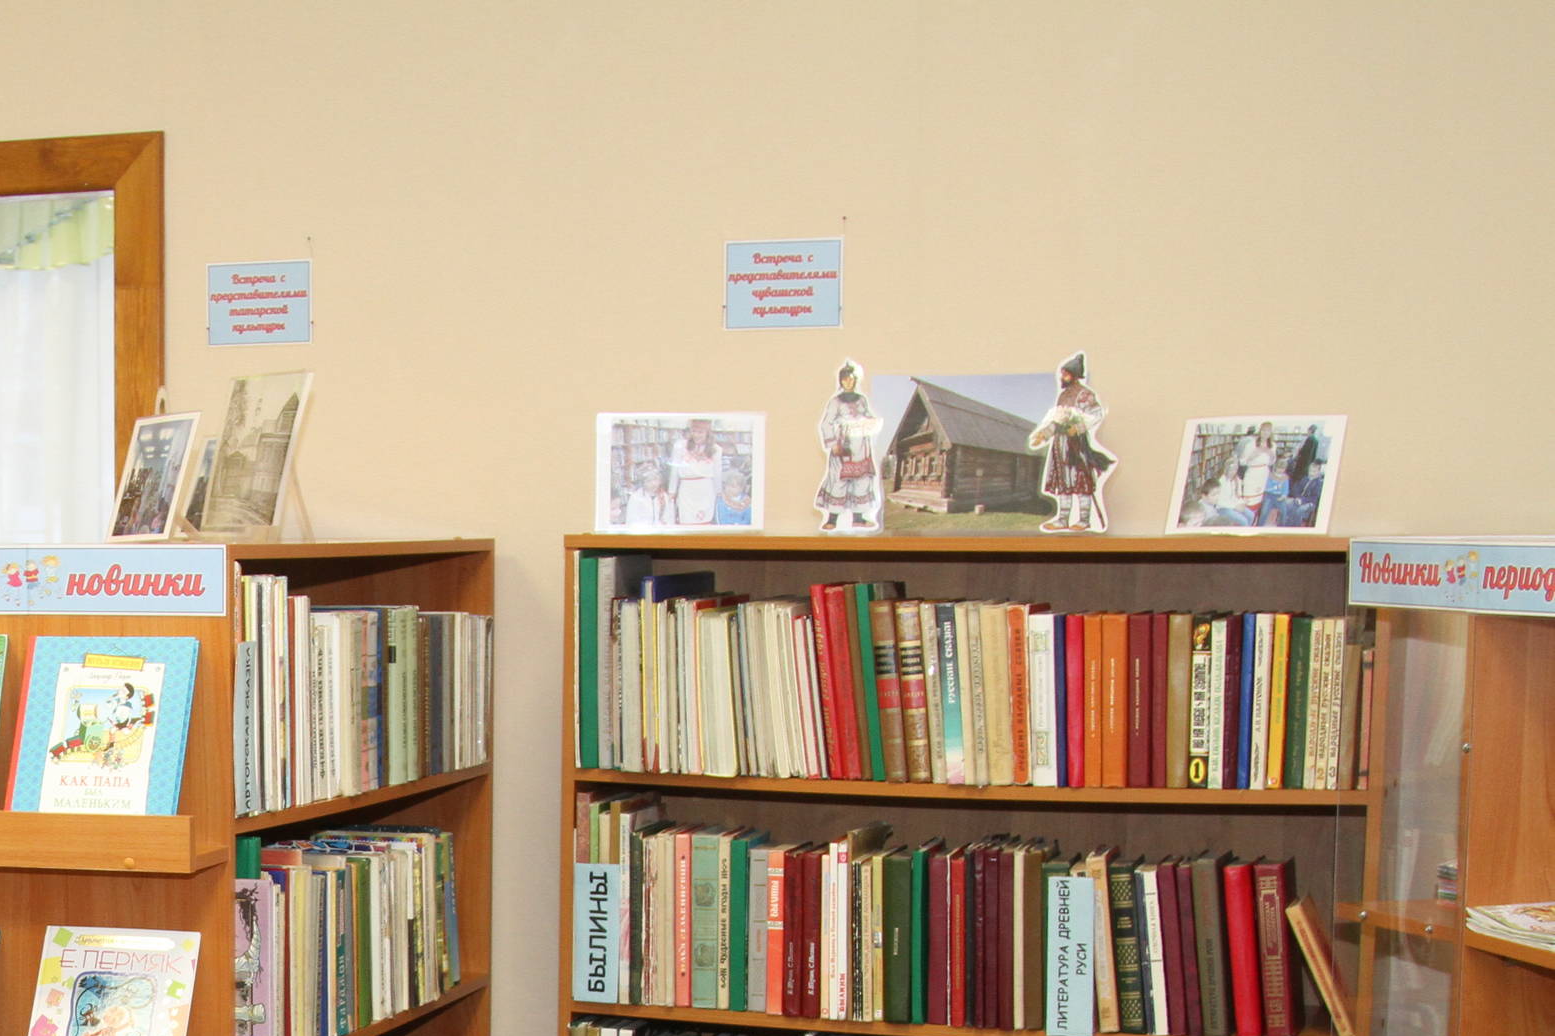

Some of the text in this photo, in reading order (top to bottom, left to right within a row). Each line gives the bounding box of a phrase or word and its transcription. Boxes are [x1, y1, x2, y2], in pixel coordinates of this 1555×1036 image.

[752, 252, 814, 265] Встреча с
[231, 274, 276, 286] Встреча
[728, 269, 837, 284] представителями
[210, 289, 307, 303] представителями
[752, 286, 814, 301] чувашской
[752, 305, 813, 317] культуры
[231, 322, 286, 334] культуры
[1359, 552, 1441, 586] Новинки
[66, 564, 205, 597] новинки
[59, 775, 131, 788] КАК ПАПА
[54, 799, 132, 809] МАЛЕНЬКИМ
[588, 871, 608, 993] БЫЛИНЫ
[82, 950, 183, 974] ПЕРМЯК
[1056, 880, 1070, 1030] ЛИТЕРАТУРА ДРЕВНЕЙ
[1076, 943, 1087, 976] РУСИ
